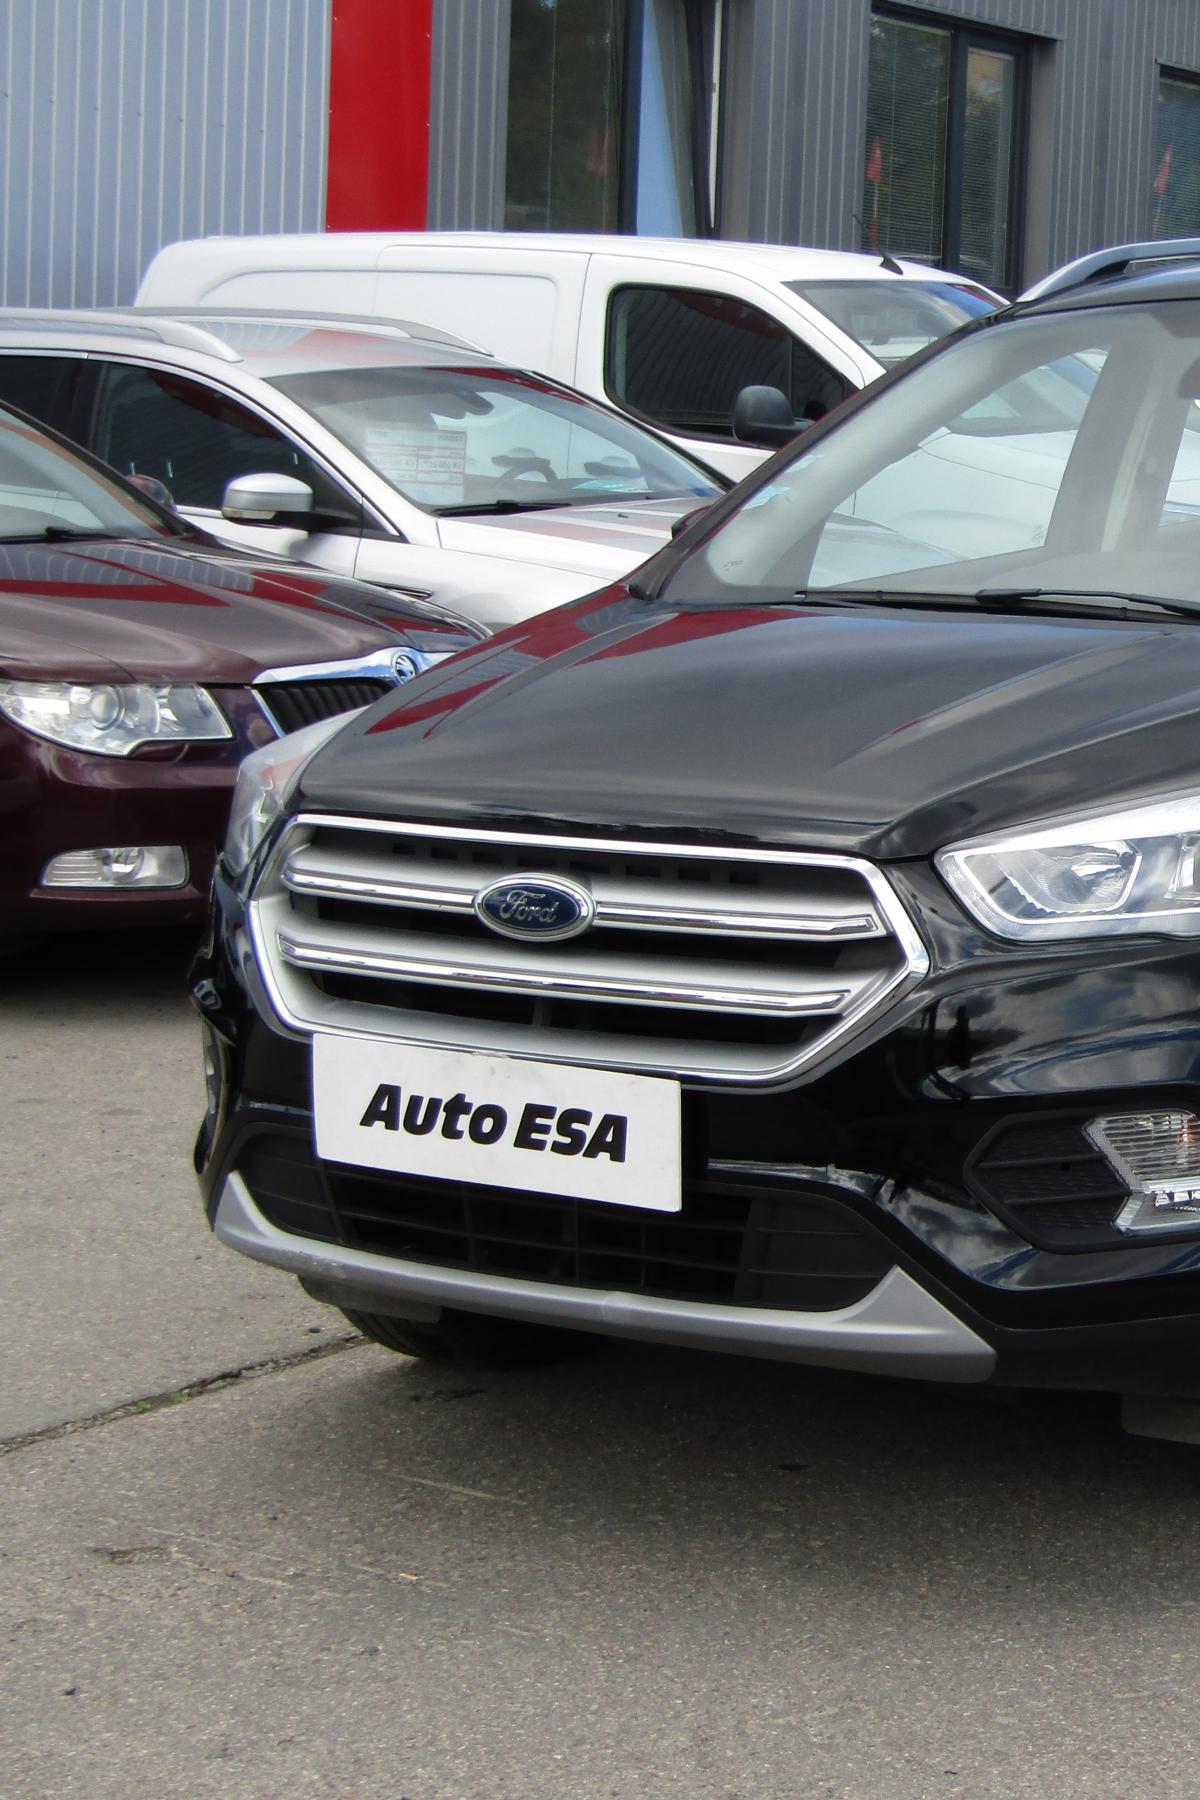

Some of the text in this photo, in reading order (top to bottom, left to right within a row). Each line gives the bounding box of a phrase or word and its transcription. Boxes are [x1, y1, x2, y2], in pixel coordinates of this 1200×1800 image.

[500, 889, 559, 923] Ford
[359, 1083, 628, 1163] Auto ESA
